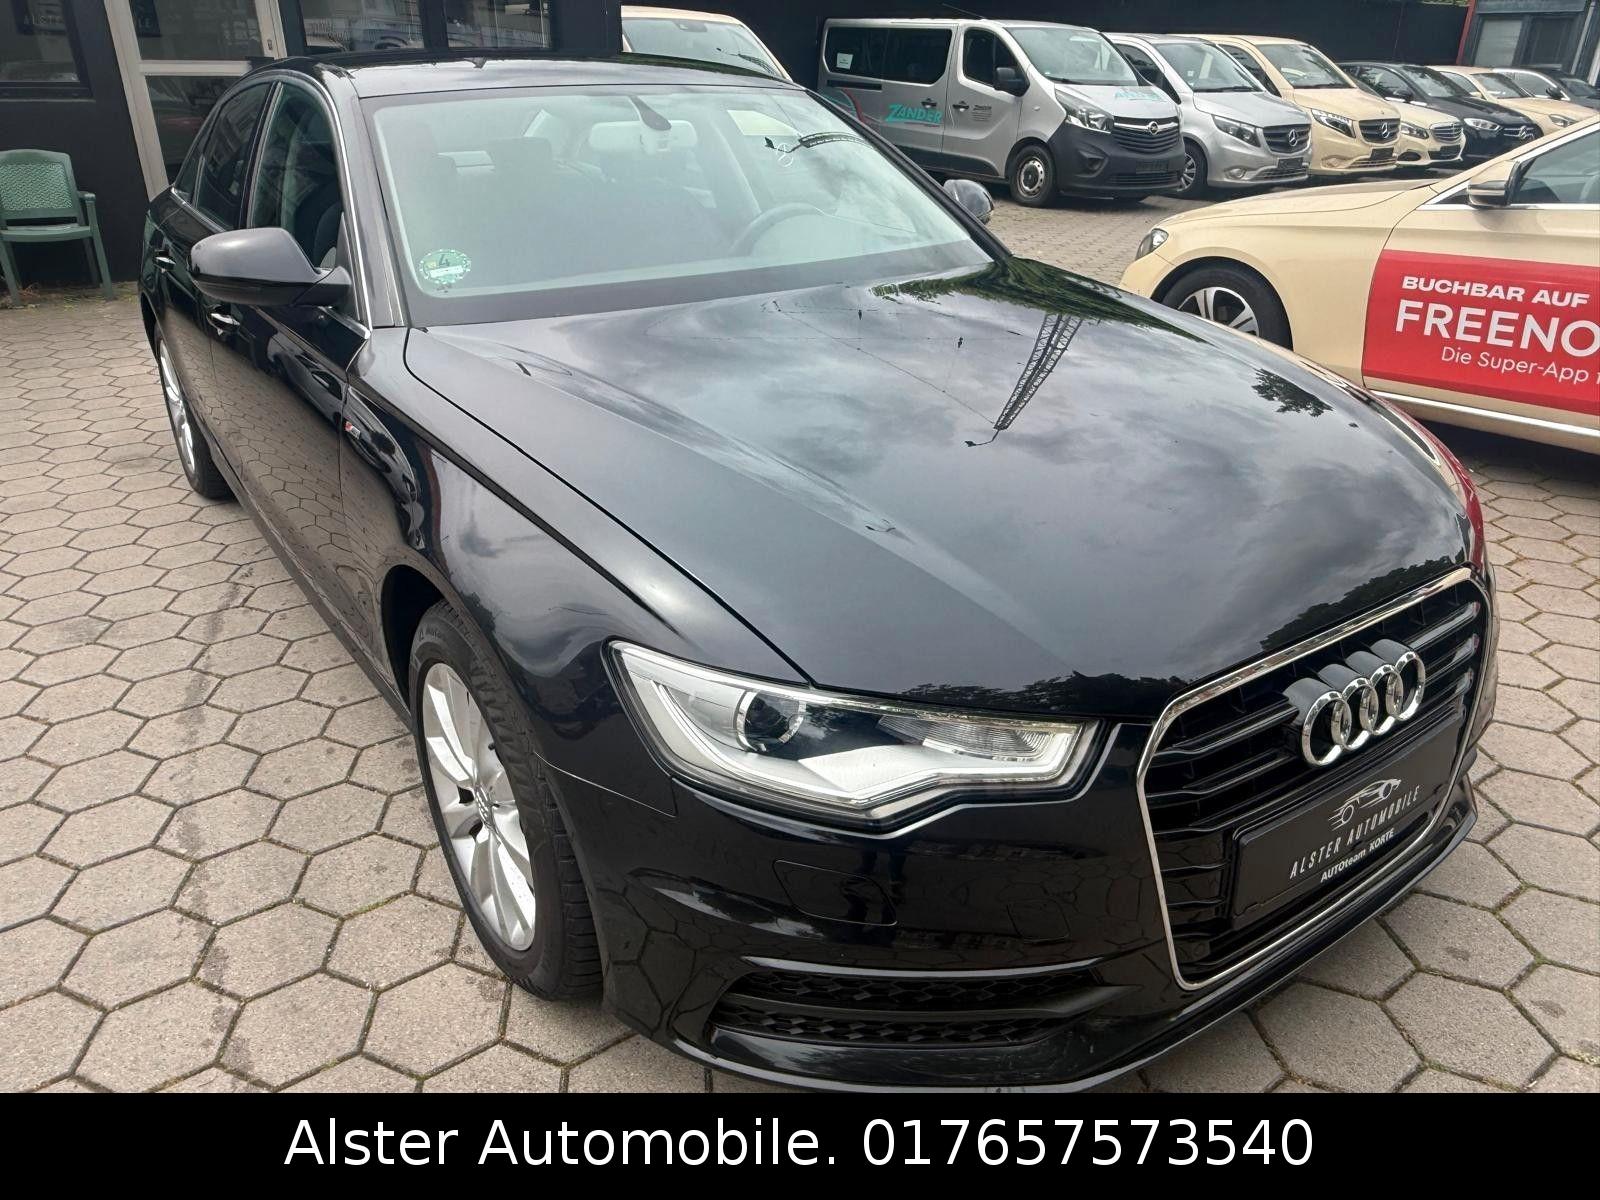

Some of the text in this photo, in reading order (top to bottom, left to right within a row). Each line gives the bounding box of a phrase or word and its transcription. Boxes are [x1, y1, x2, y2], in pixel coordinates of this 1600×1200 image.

[886, 103, 942, 124] ZANDER
[1402, 275, 1590, 308] BUCHBAR AUF
[1395, 299, 1600, 357] FREENO
[1441, 346, 1472, 365] Die
[1477, 352, 1589, 385] Super-App
[1290, 785, 1420, 880] ALSTER AUTOMOBILE
[1320, 828, 1395, 883] AUTOteam KORTE
